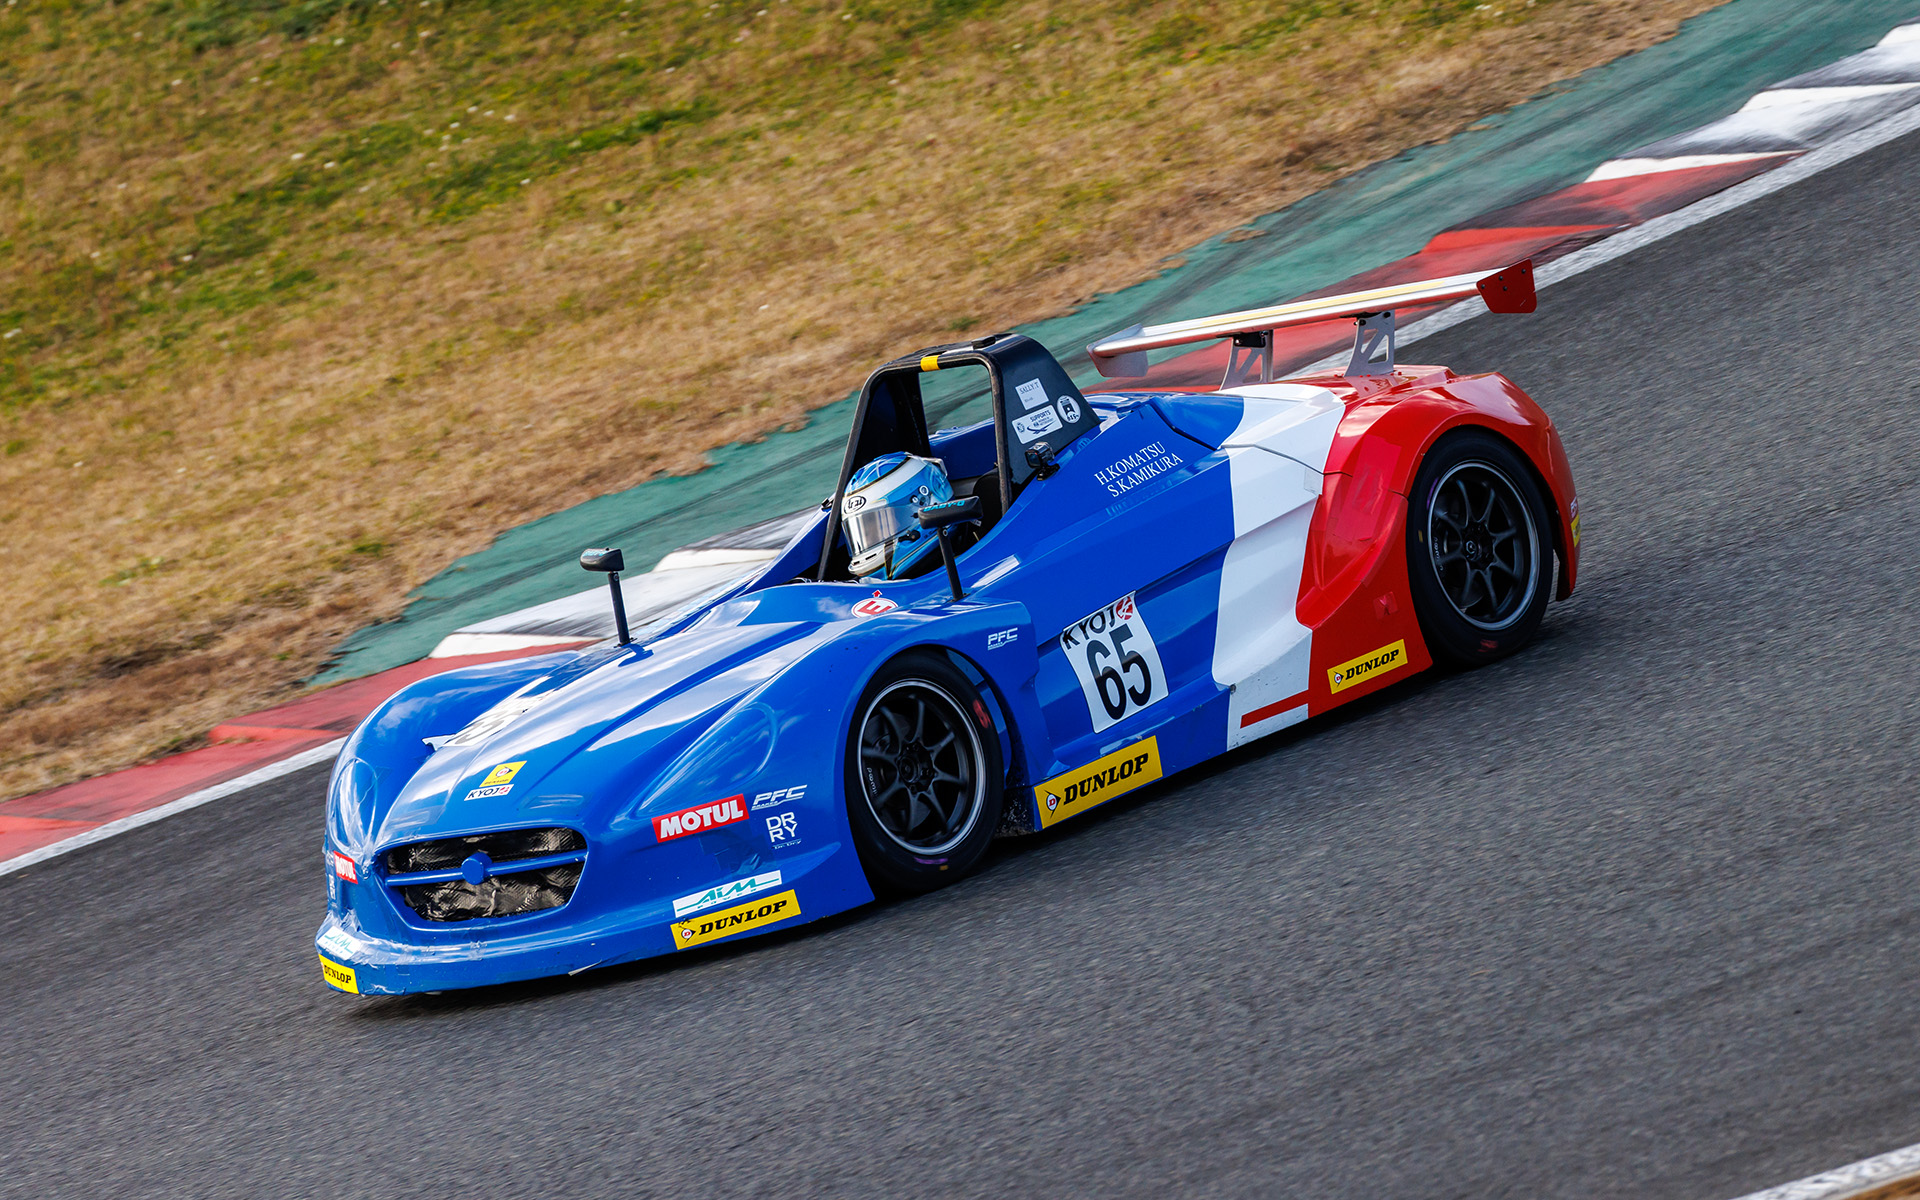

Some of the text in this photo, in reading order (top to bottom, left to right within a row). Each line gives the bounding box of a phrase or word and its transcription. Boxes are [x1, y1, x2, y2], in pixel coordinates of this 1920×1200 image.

[1094, 441, 1166, 485] H.KOMATSU
[1107, 453, 1183, 497] S.KAMIKURA
[987, 627, 1018, 645] PFC
[1086, 623, 1152, 721] 65
[1345, 649, 1400, 680] DUNLOP
[753, 785, 808, 806] PFC
[1063, 753, 1149, 805] DUNLOP
[660, 799, 744, 839] MOTUL
[699, 900, 787, 936] DUNLOP
[324, 964, 352, 984] DUNLOP
